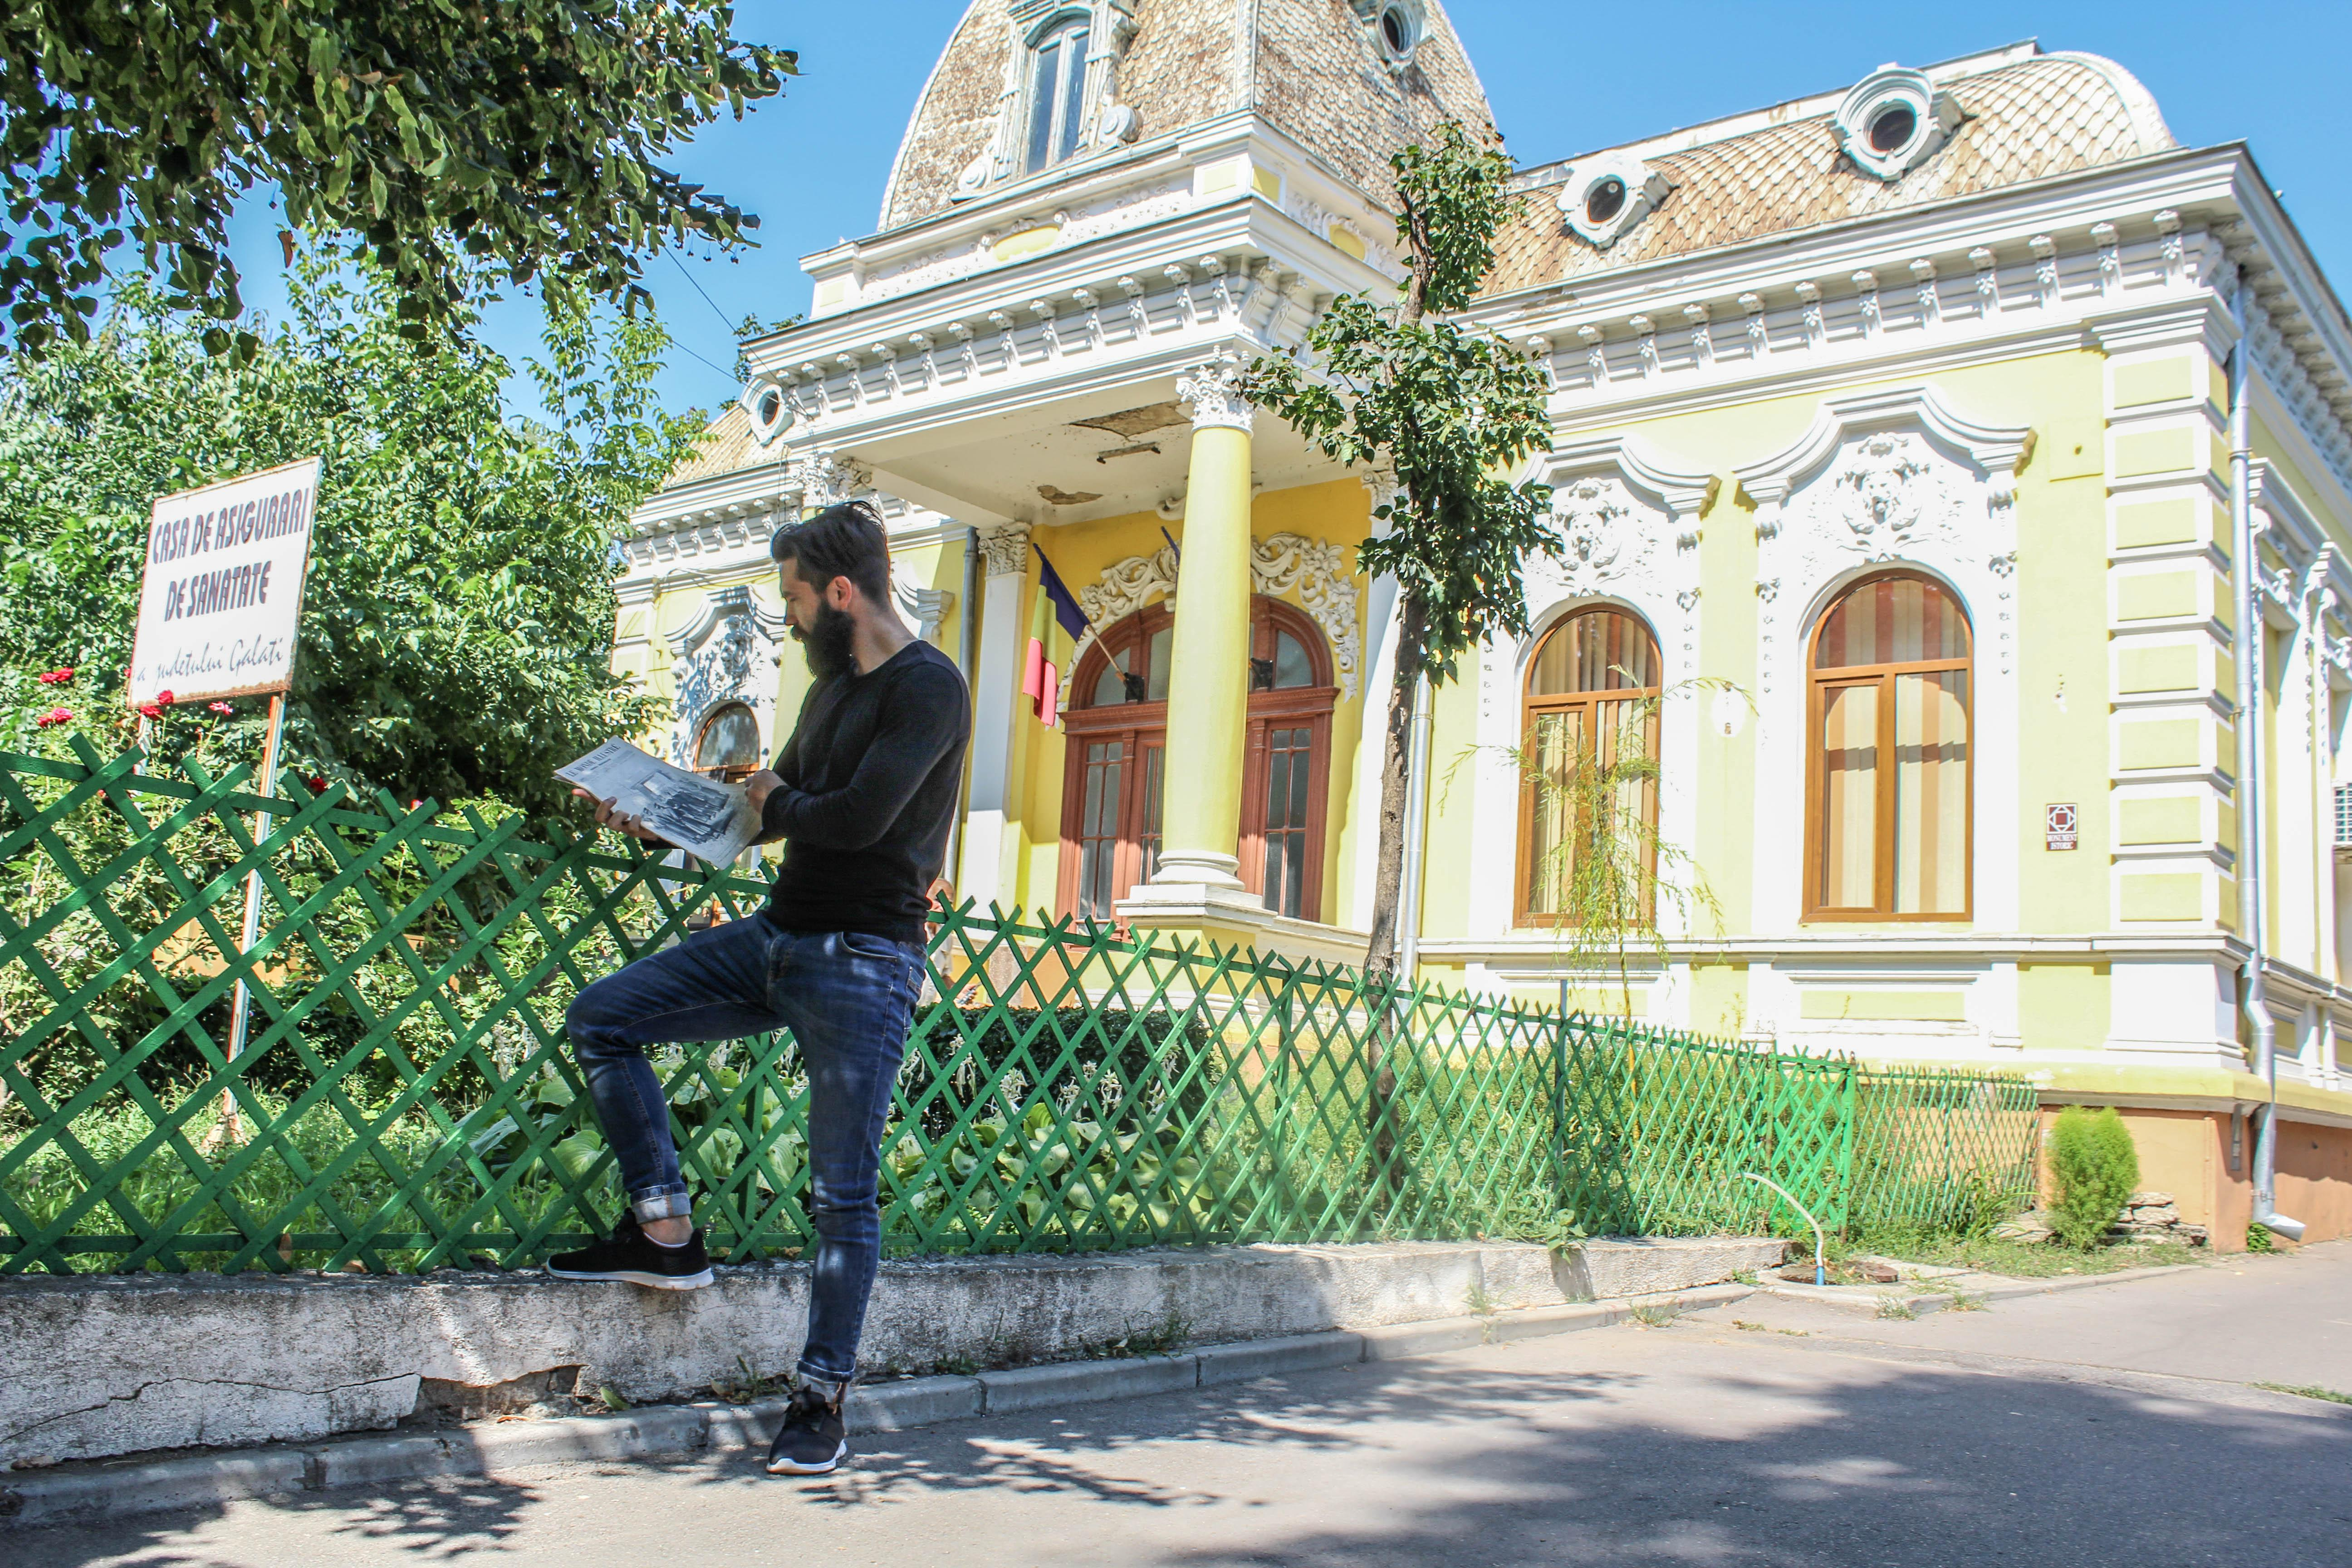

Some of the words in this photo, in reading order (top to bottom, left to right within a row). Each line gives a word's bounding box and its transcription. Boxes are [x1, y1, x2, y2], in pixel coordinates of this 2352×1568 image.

[153, 517, 189, 564] CASA
[191, 511, 215, 556] DE
[214, 488, 309, 550] ASIGURARI
[164, 578, 187, 622] DE
[186, 560, 272, 617] SANATATE
[137, 667, 146, 682] a
